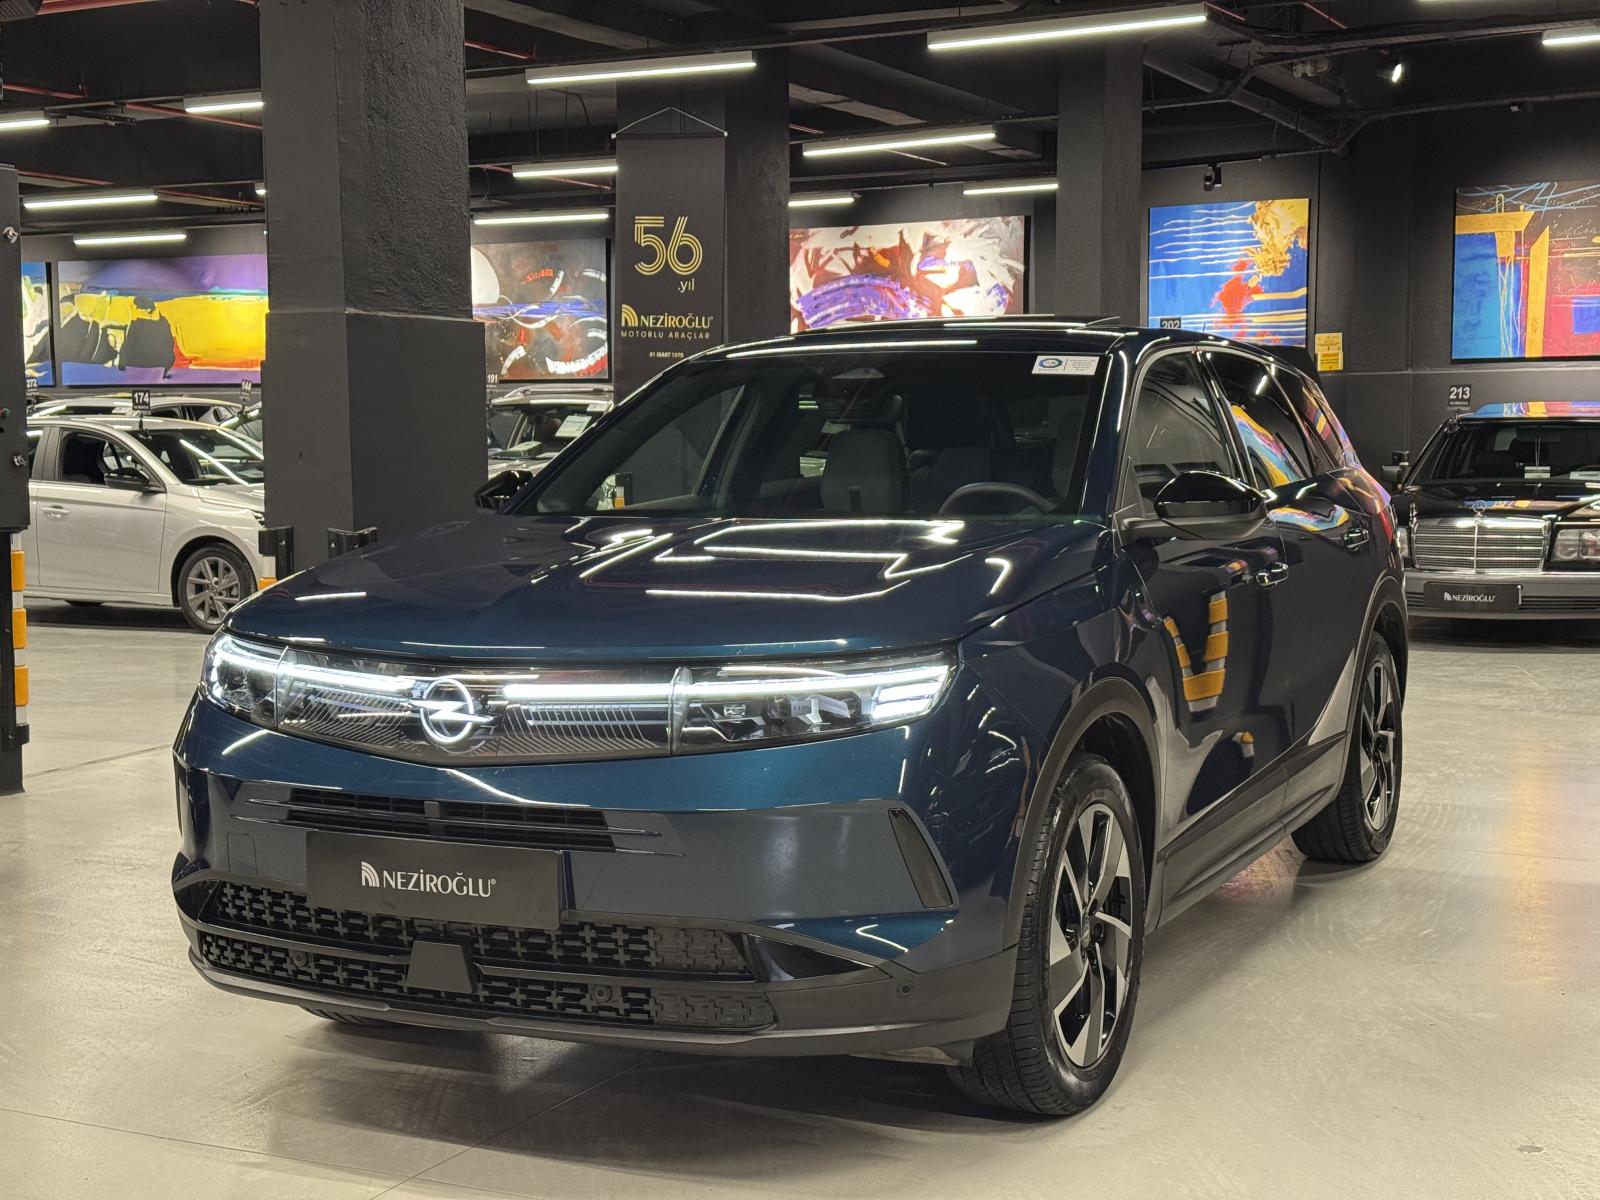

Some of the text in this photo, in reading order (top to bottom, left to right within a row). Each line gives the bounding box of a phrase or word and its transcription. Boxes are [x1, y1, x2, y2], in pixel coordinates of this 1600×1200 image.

[634, 216, 703, 275] 56
[1161, 320, 1180, 329] 202
[621, 330, 710, 341] MOTORLU ARAÇLAR
[133, 391, 150, 404] 174
[1449, 386, 1470, 399] 213
